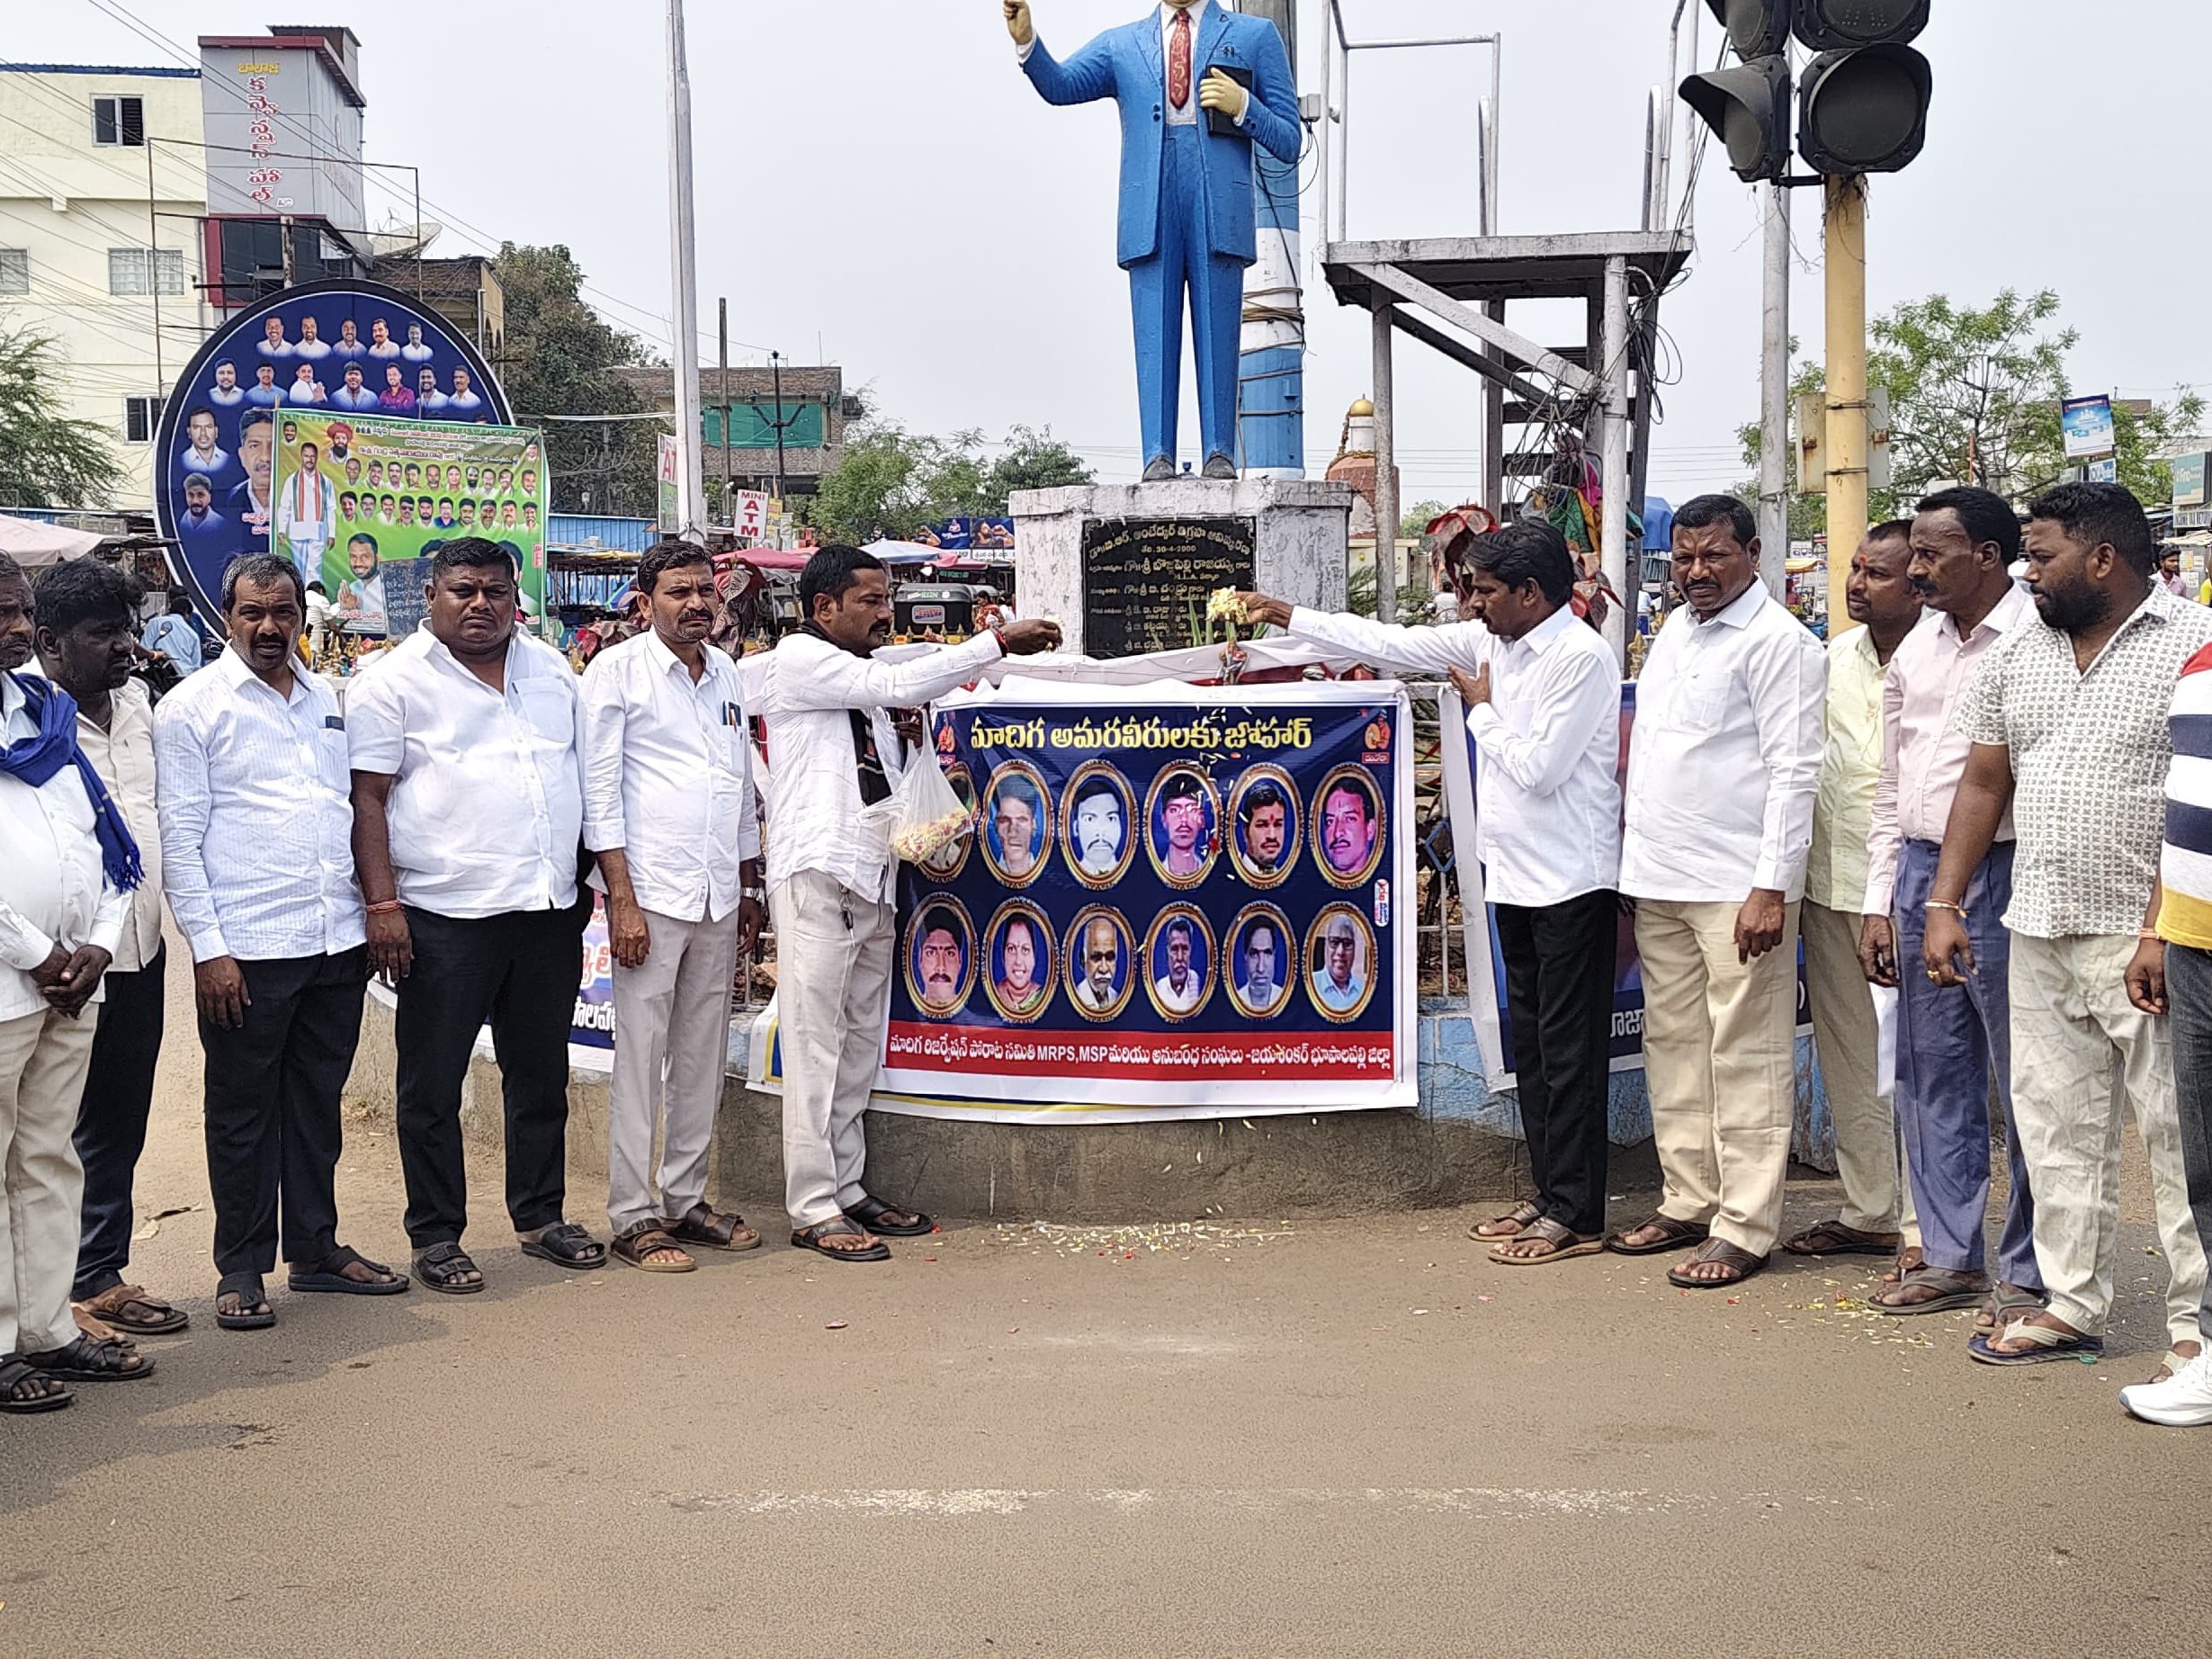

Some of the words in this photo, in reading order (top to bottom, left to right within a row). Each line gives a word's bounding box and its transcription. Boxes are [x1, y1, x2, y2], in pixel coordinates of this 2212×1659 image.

[741, 491, 765, 500] MINI
[740, 500, 760, 537] ATM
[971, 716, 1045, 749] మాదిగ
[1051, 715, 1219, 749] అమరవీరులకు
[1224, 717, 1313, 749] జోహార్
[890, 1035, 923, 1054] మాదిగ
[1005, 1042, 1035, 1062] సమితి
[1108, 1045, 1151, 1063] మరియు
[1311, 1045, 1366, 1070] భూపాలపల్లి
